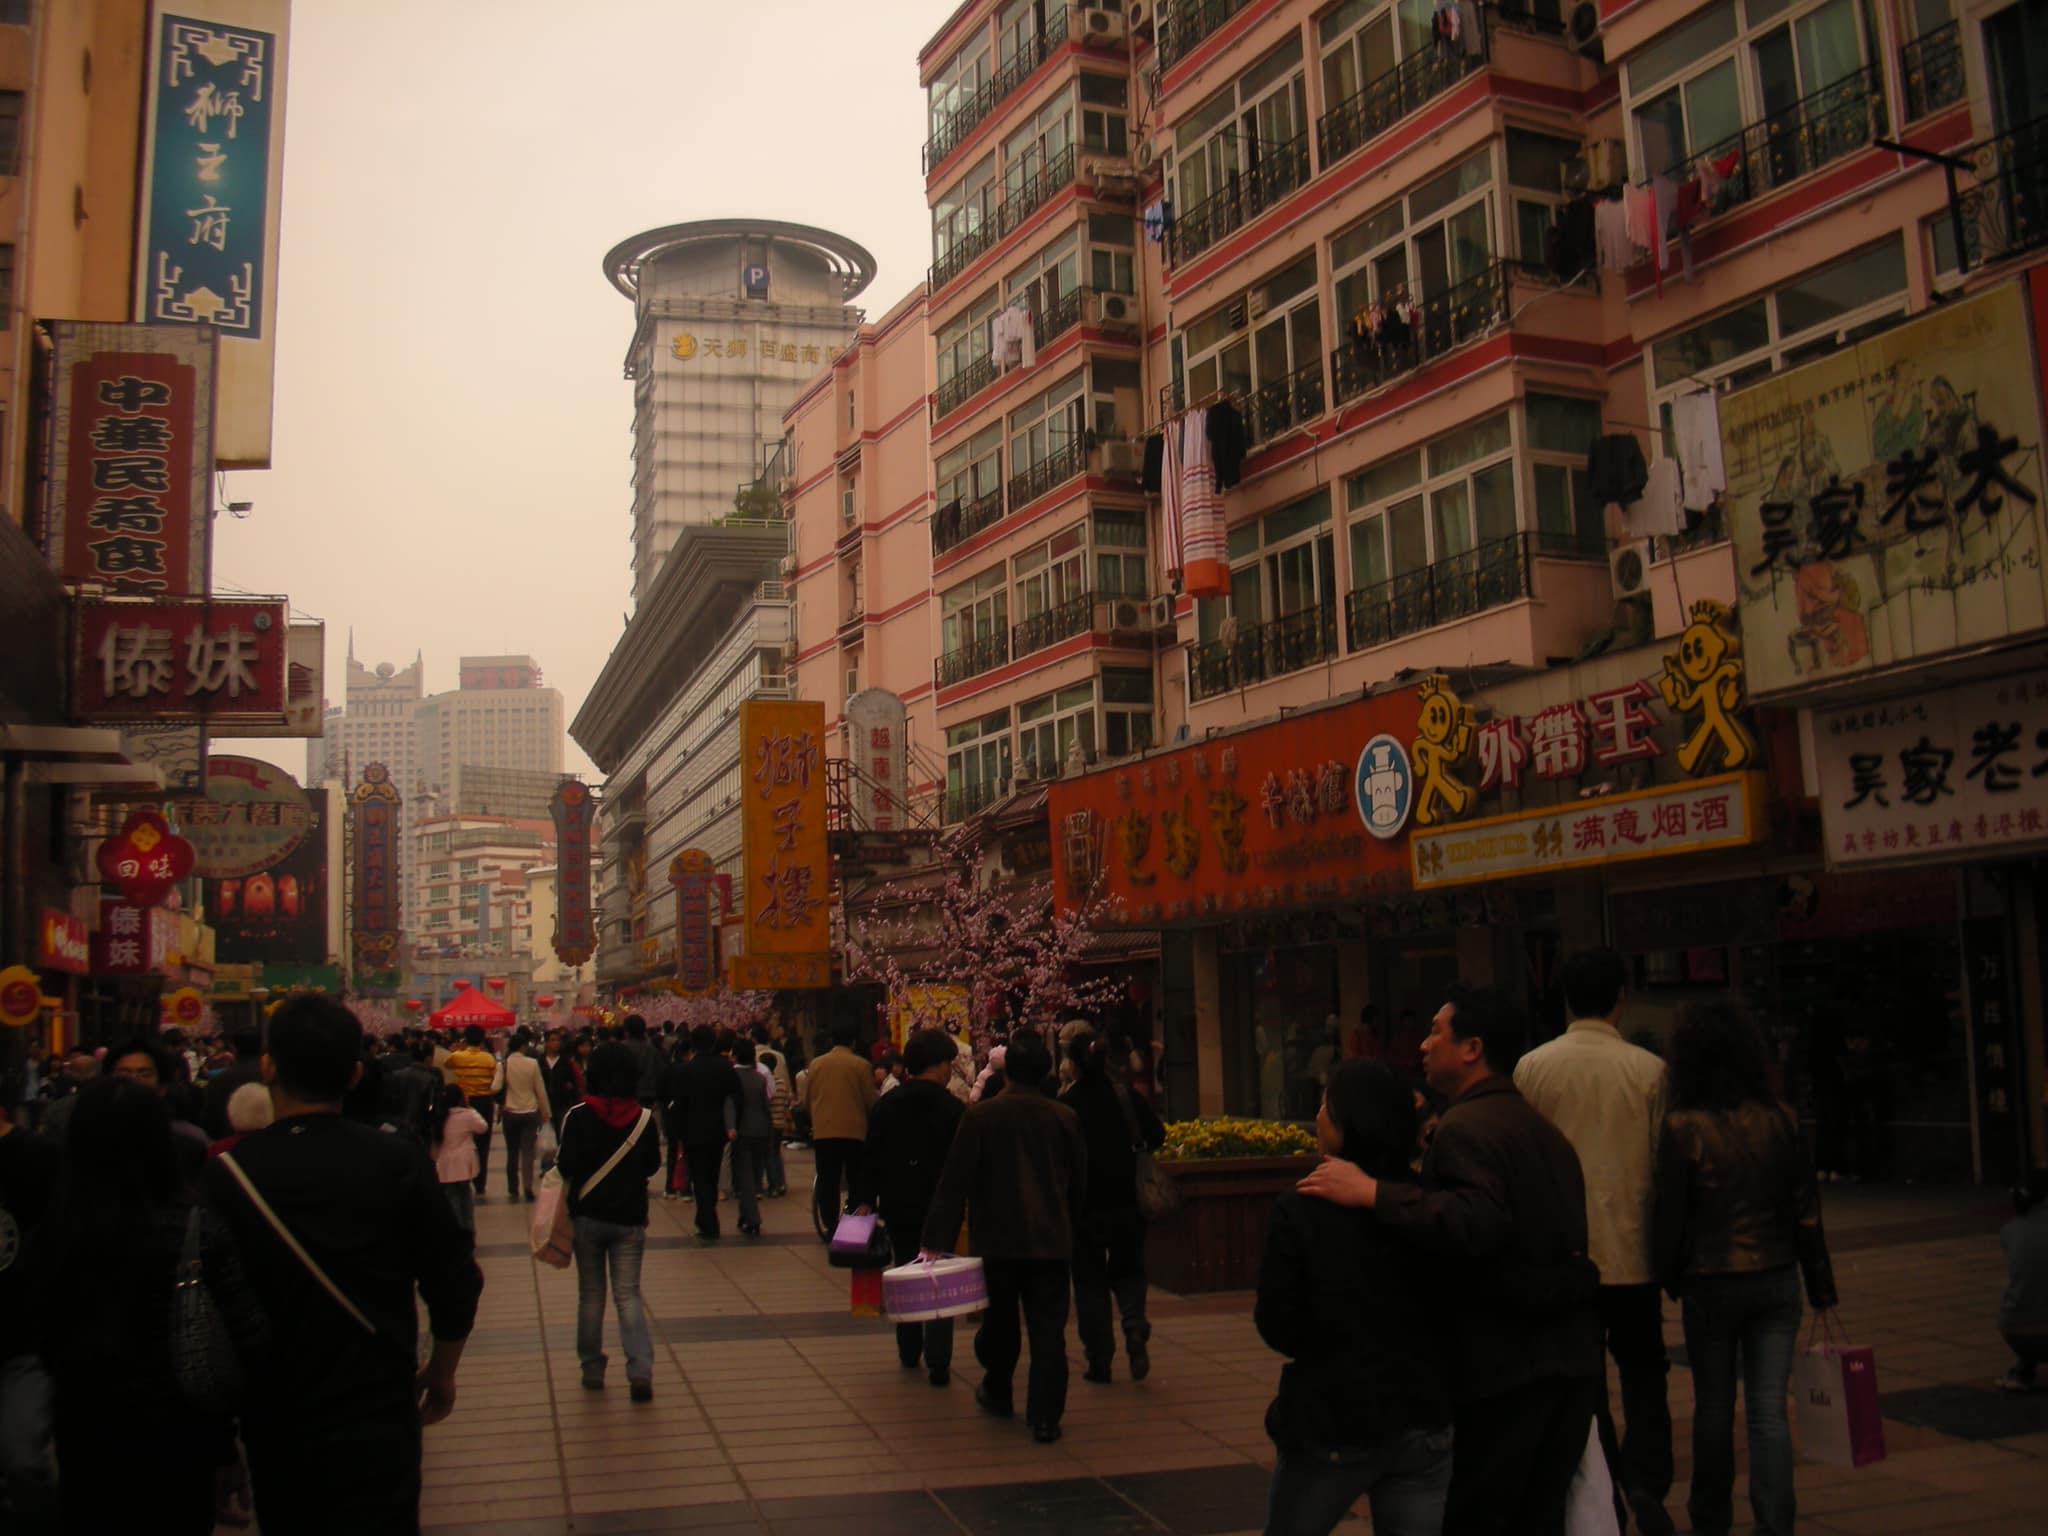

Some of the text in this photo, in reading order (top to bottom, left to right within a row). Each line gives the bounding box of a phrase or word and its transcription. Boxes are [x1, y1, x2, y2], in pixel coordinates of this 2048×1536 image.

[759, 339, 839, 365] 百盛商
[97, 622, 258, 698] 傣妹
[1571, 795, 1730, 851] 满意烟酒
[117, 853, 174, 880] 回味
[109, 905, 144, 967] 傣妹
